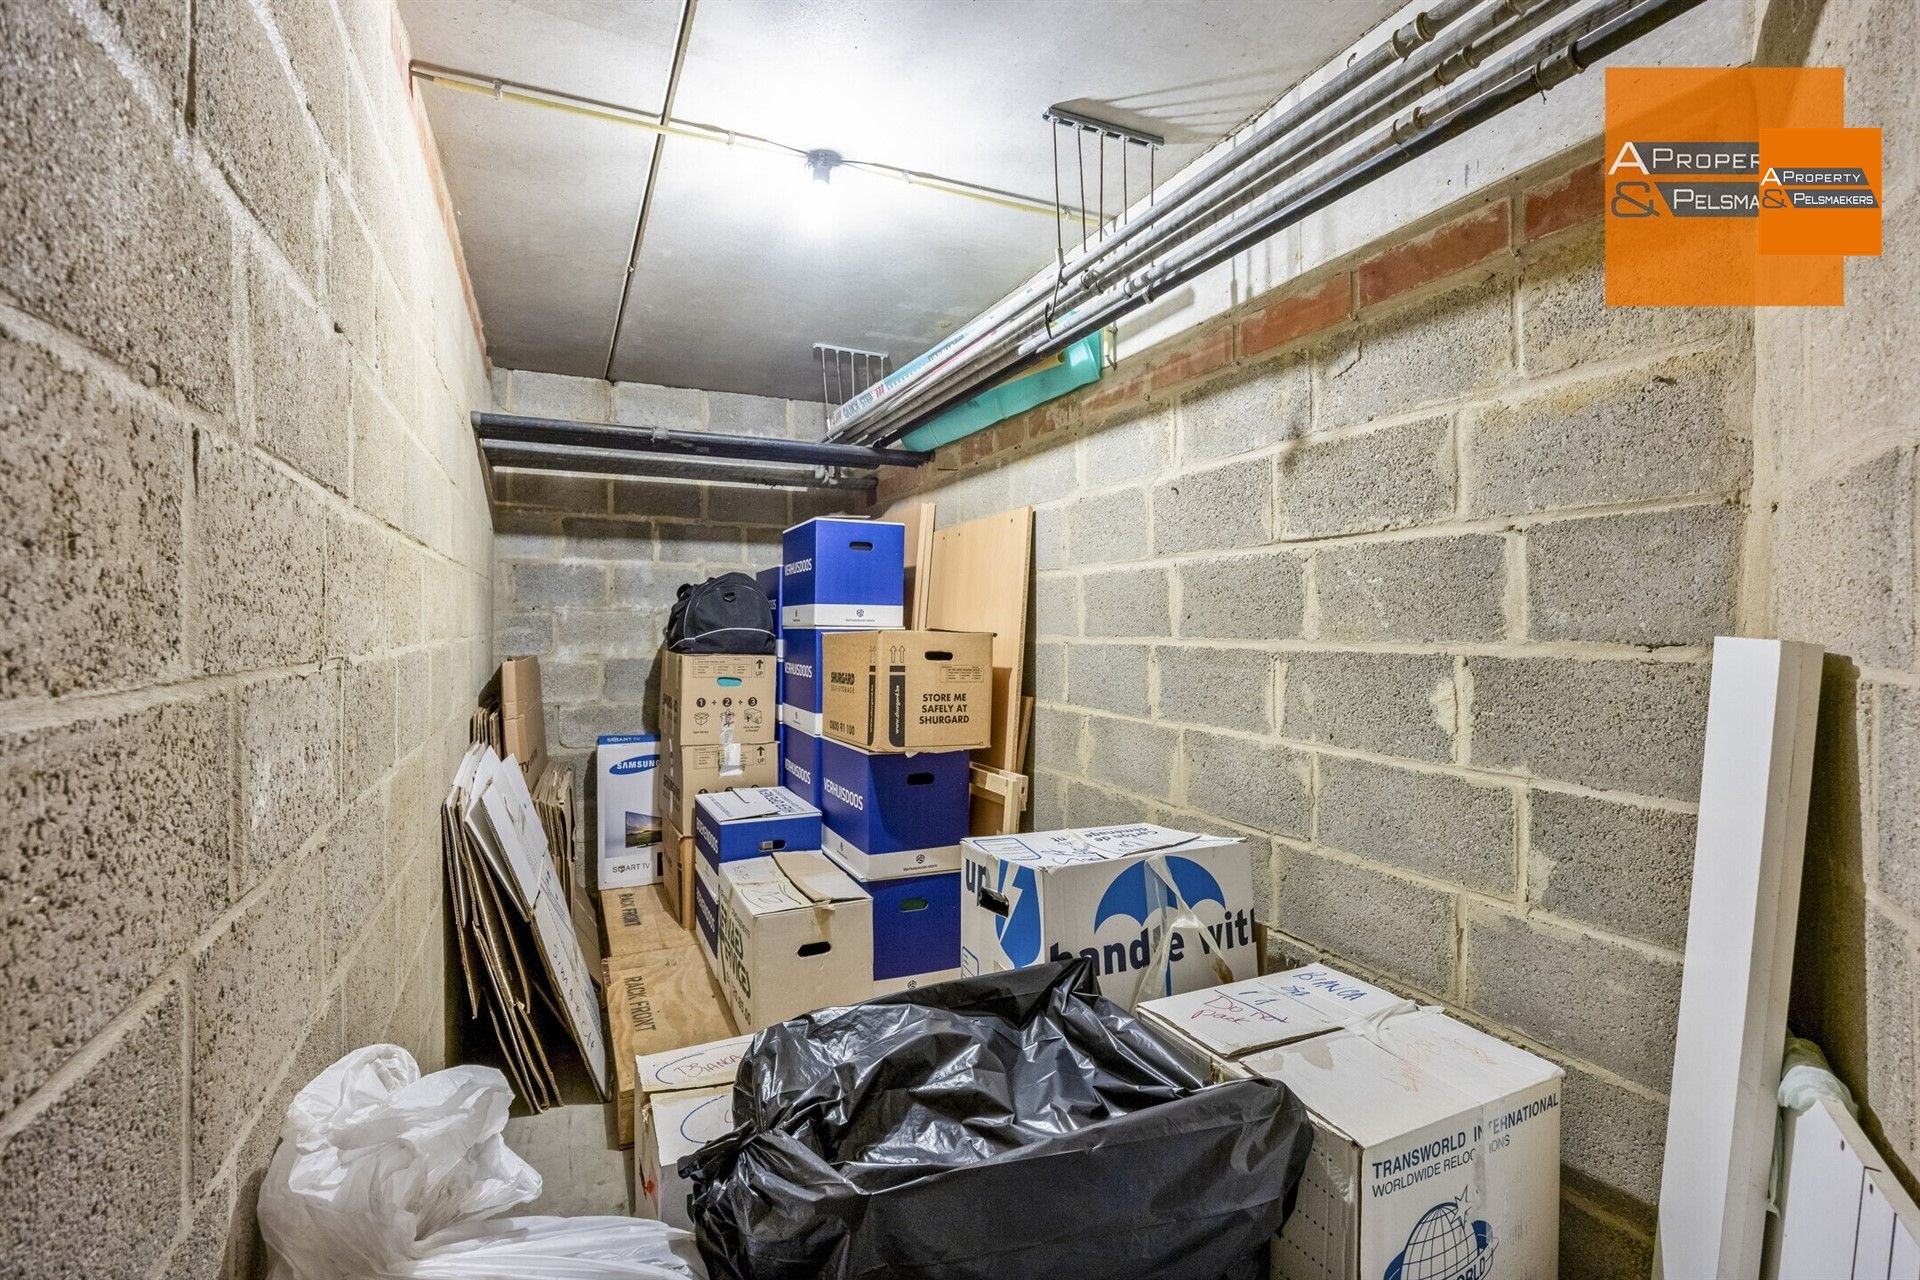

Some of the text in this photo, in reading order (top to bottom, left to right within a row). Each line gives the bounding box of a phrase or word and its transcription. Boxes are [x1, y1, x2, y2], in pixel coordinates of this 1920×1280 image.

[922, 693, 967, 702] STORE ME
[921, 704, 967, 713] SAFELY AT
[919, 715, 970, 724] SHURGARD
[823, 777, 864, 811] VERHUISDOOS
[641, 862, 650, 870] TV
[624, 975, 657, 1032] RACK FRONT
[1372, 1132, 1466, 1179] TRANSWORLD
[1372, 1166, 1441, 1198] WORLDWIDE
